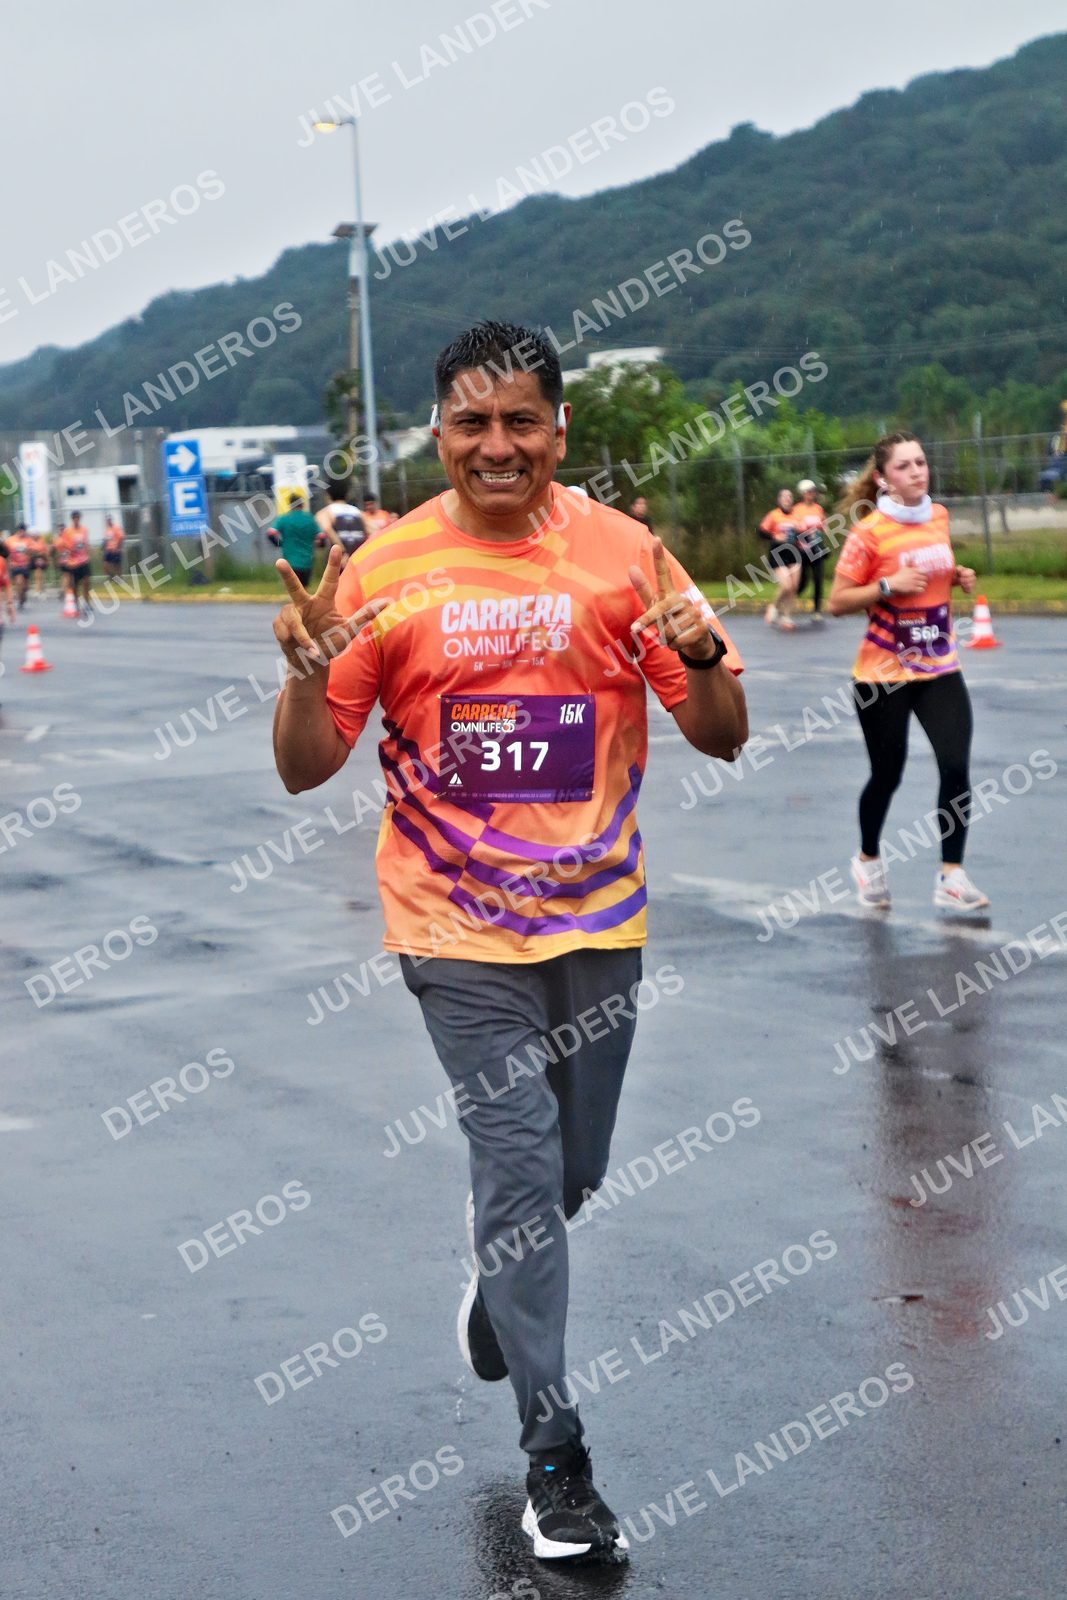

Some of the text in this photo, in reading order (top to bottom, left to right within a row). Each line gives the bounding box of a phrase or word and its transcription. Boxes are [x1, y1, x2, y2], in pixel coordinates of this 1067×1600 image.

[173, 481, 202, 516] E
[441, 593, 572, 634] CARRERA
[911, 624, 940, 641] 560
[451, 703, 516, 721] CARRERA
[559, 704, 586, 724] 15K
[451, 721, 502, 733] OMNILIFE
[481, 741, 549, 772] 317
